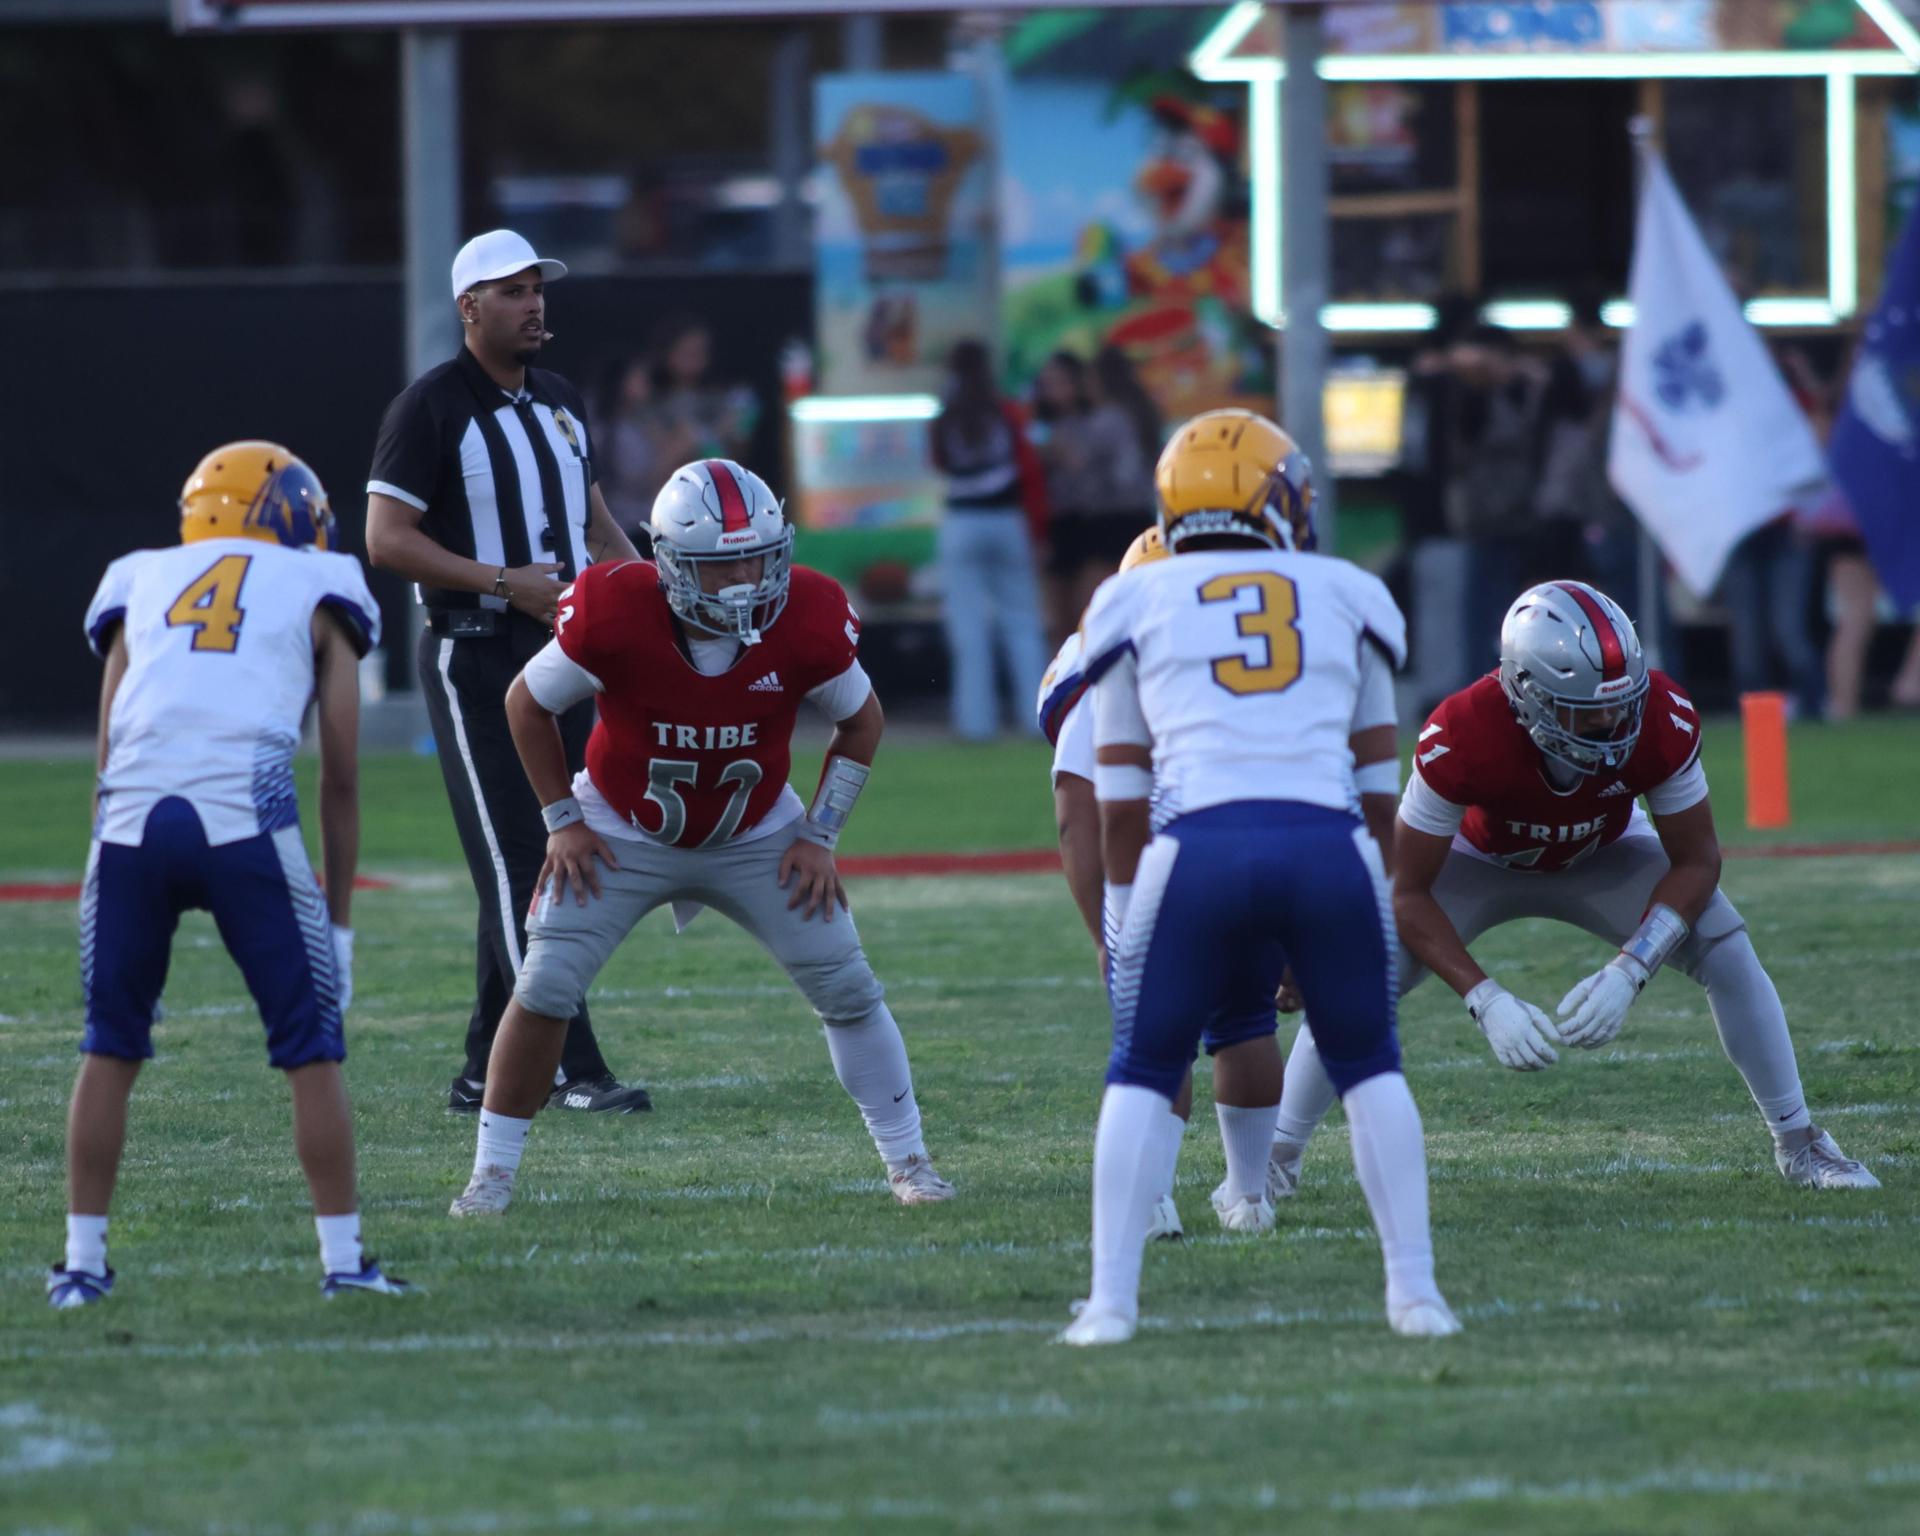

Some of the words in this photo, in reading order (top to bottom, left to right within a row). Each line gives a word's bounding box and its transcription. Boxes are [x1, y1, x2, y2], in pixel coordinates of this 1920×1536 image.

[164, 554, 253, 653] 4
[1196, 570, 1304, 697] 3
[651, 721, 758, 749] TRIBE
[1667, 689, 1695, 740] 11
[1418, 723, 1451, 768] 11
[631, 757, 763, 848] 52
[1505, 813, 1608, 843] TRIBE
[564, 1092, 592, 1109] HOKA
